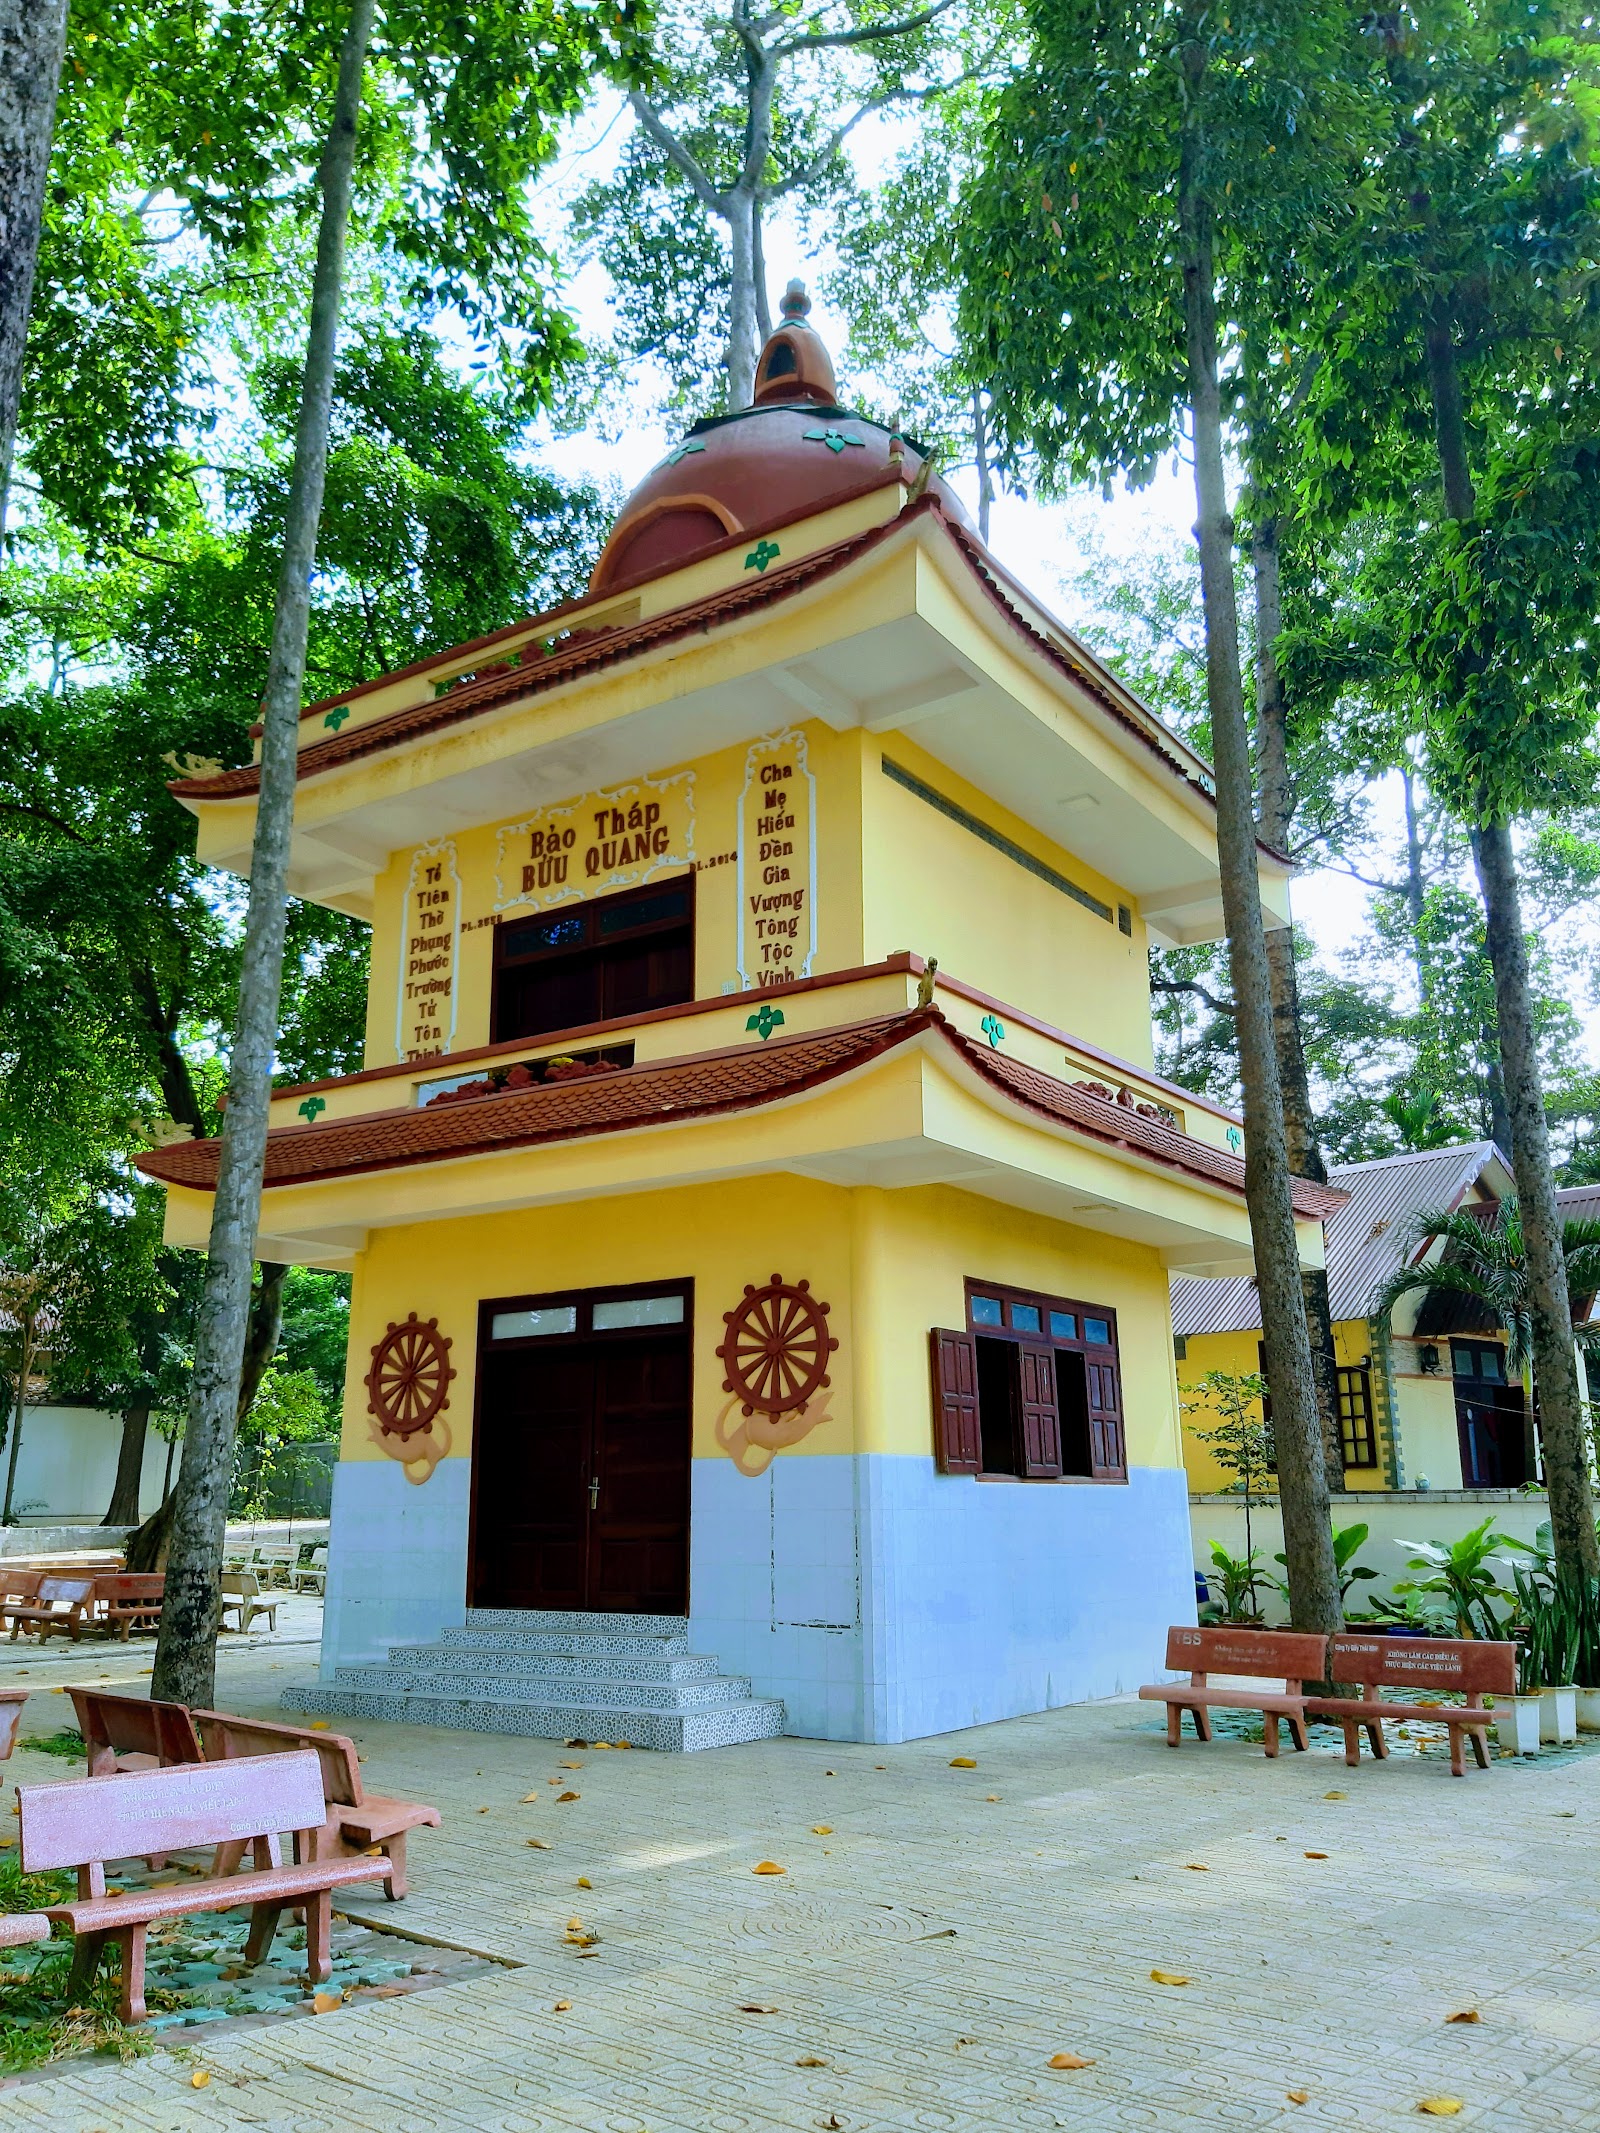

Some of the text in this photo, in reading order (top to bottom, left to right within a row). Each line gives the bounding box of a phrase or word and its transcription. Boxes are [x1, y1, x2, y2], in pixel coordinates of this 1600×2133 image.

[760, 764, 792, 784] Cha
[765, 789, 787, 809] Mẹ
[531, 801, 660, 859] Bảo Tháp
[757, 810, 795, 836] Hiếu
[521, 826, 670, 893] BỬU QUANG
[760, 839, 793, 861] Đền
[763, 866, 790, 885] Gia
[750, 889, 804, 914] Vượng
[420, 910, 444, 929] Thờ
[755, 916, 800, 938] Tông
[410, 933, 452, 954] Phụng
[761, 943, 793, 965] Tộc
[409, 954, 449, 976] Phước
[406, 976, 452, 999] Trường
[414, 1024, 442, 1042] Tôn
